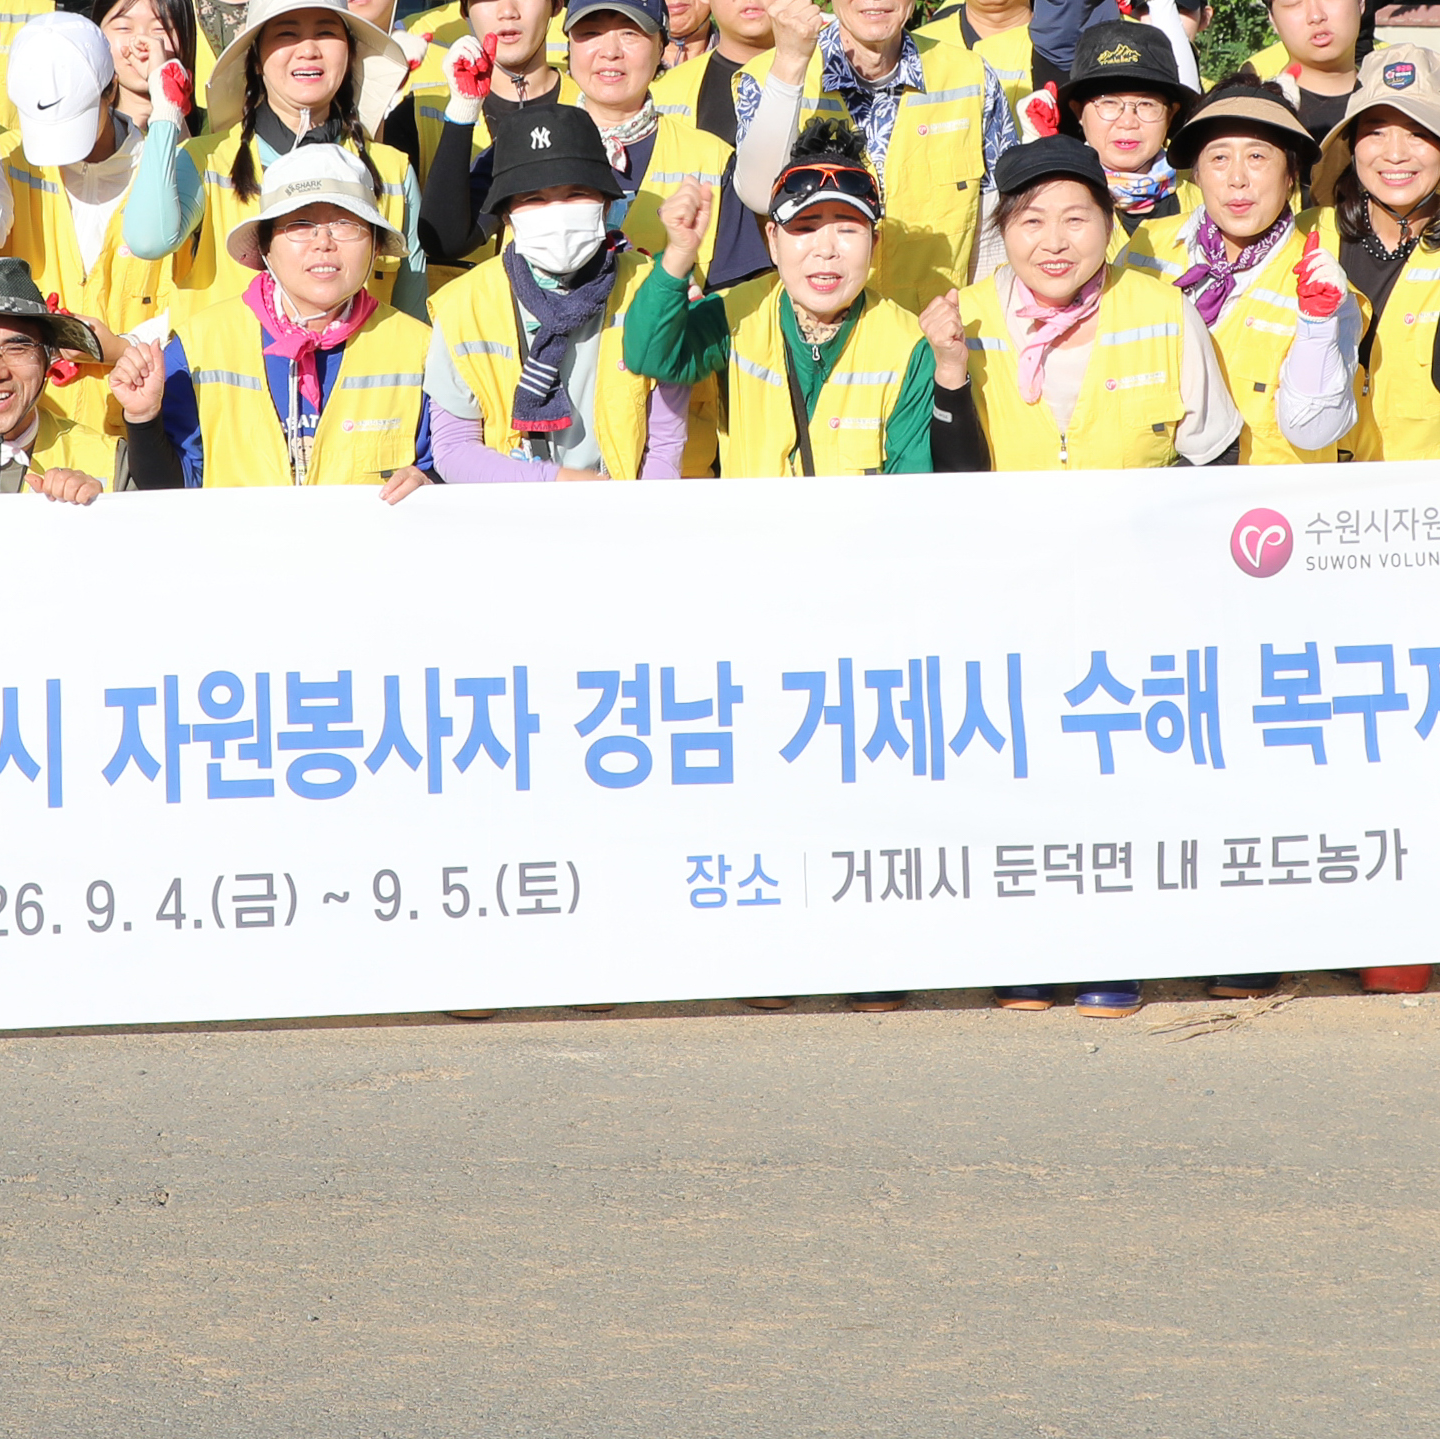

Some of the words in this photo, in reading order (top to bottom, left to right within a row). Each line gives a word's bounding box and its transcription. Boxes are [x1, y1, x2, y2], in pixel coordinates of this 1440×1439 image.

[530, 126, 551, 150] NY
[295, 179, 322, 190] SHARK
[1306, 554, 1371, 571] SUWON
[101, 665, 541, 804] 자원봉사자
[573, 660, 744, 790] 경남
[778, 652, 1029, 784] 거제시
[1060, 645, 1226, 775] 수해
[685, 853, 782, 909] 장소
[831, 845, 971, 903] 거제시
[993, 841, 1134, 898] 둔덕면
[1157, 839, 1198, 891] 내
[1220, 827, 1408, 888] 포도농가
[322, 891, 350, 904] ~
